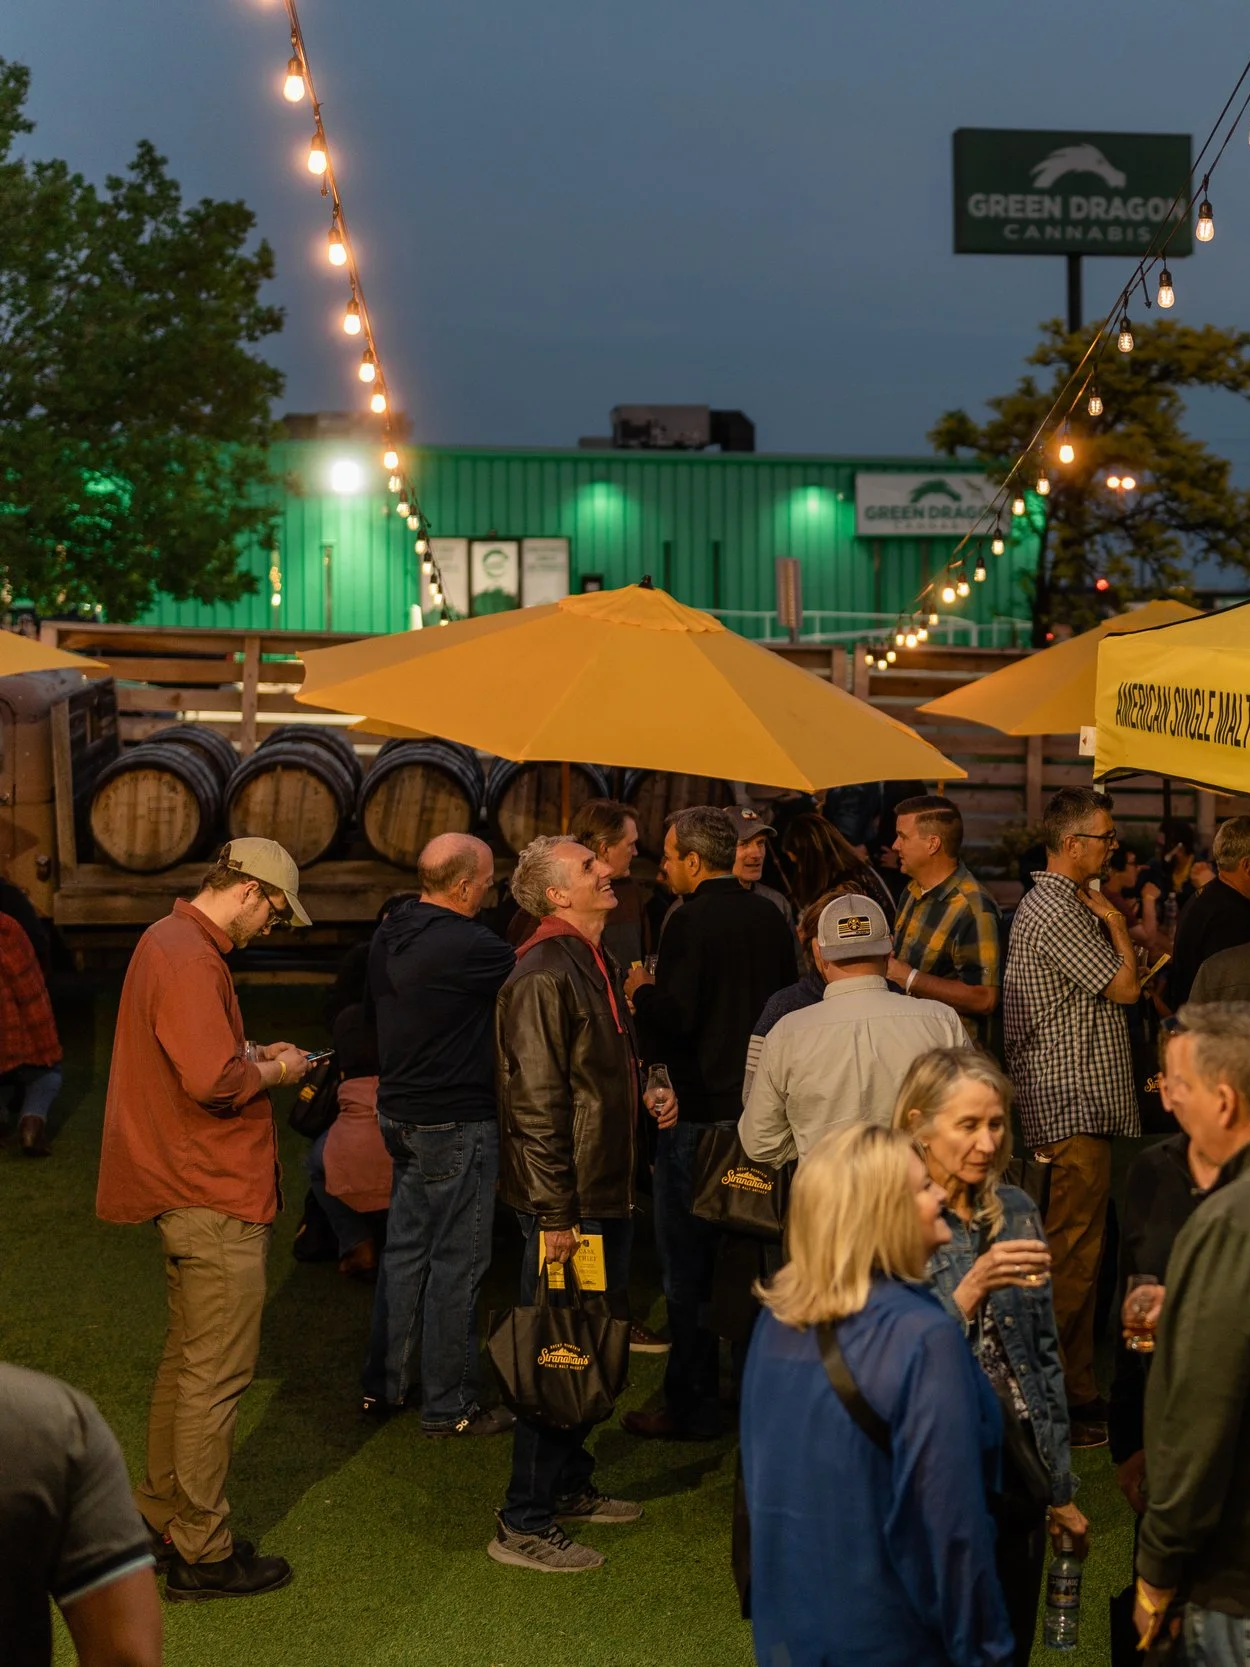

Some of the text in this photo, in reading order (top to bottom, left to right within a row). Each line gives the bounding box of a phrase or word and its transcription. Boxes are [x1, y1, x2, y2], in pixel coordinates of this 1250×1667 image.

[968, 193, 1187, 221] GREEN DRAGON
[1003, 223, 1152, 243] CANNABIS
[865, 504, 926, 520] GREEN
[1115, 681, 1172, 735] AMERICAN
[1169, 686, 1217, 742] SINGLE
[721, 1169, 772, 1191] Stranahan's
[537, 1347, 590, 1366] Stranahan's
